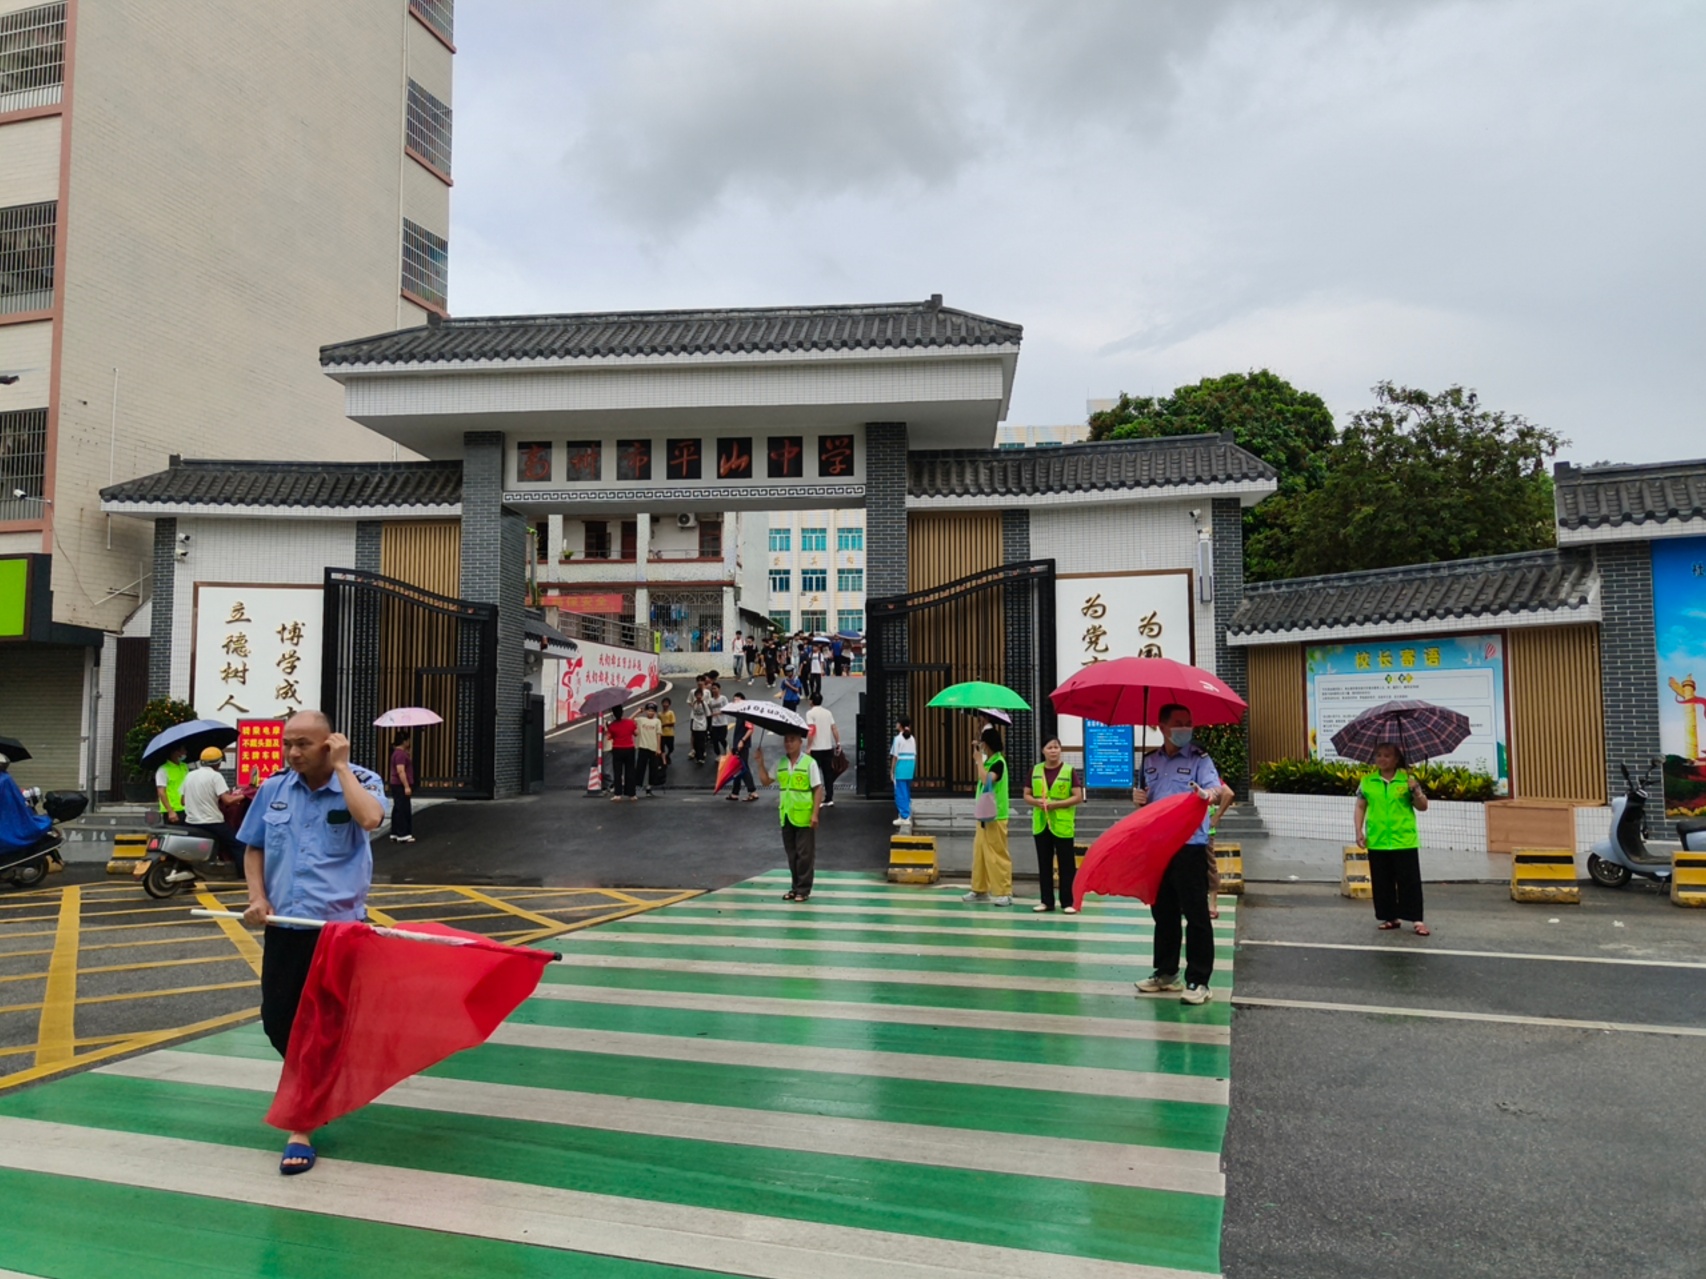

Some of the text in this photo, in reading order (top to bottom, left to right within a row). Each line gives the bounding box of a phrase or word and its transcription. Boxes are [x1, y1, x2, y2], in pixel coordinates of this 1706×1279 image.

[522, 436, 852, 480] 高州市平山中学
[216, 602, 252, 713] 立德树人
[1355, 647, 1441, 669] 校长寄语
[241, 750, 280, 761] 无牌车辆
